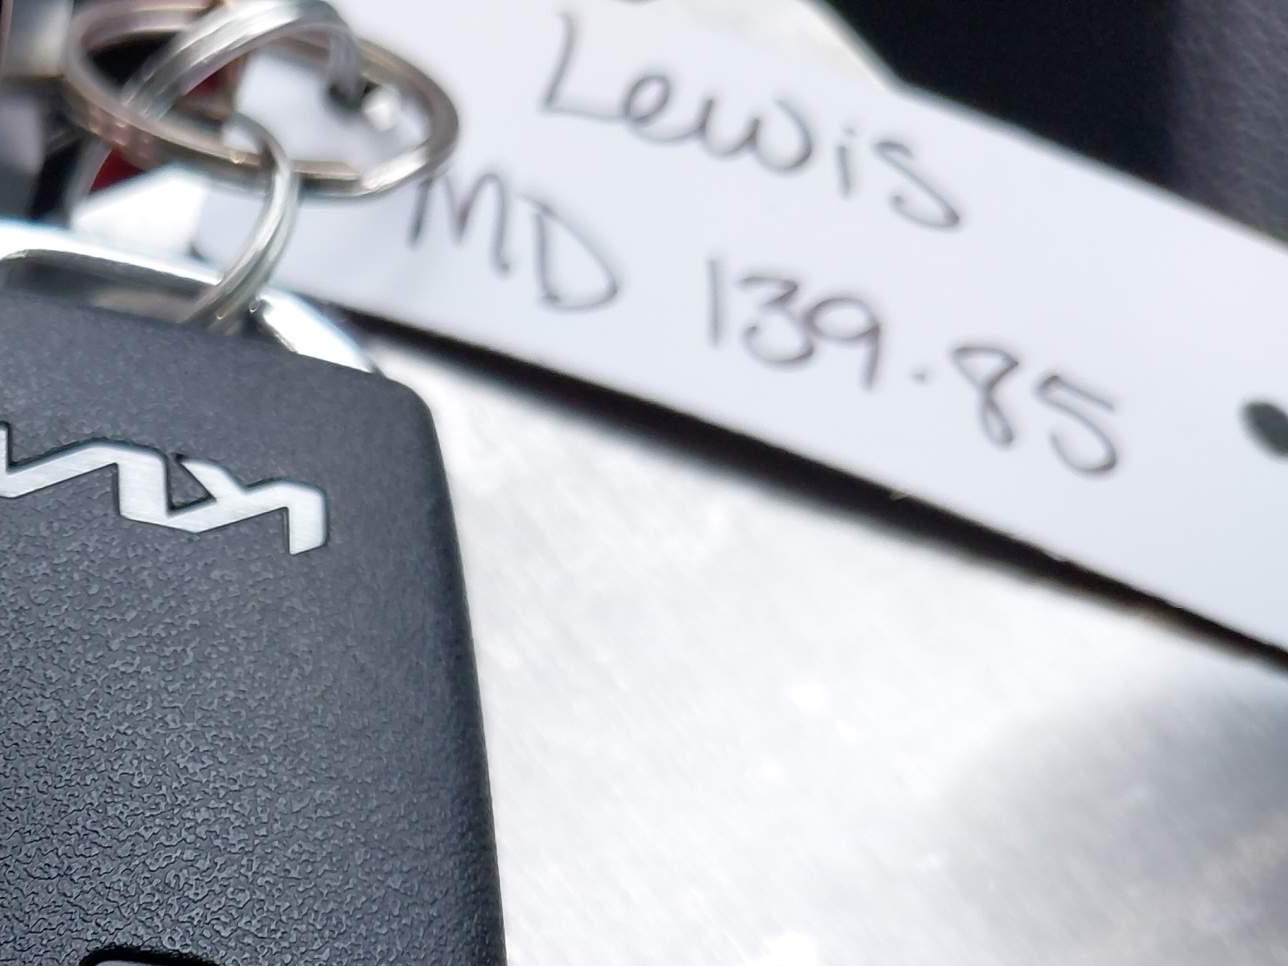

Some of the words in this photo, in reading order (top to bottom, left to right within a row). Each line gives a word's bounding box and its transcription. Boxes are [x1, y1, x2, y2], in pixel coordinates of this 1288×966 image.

[538, 12, 963, 231] Lewis
[406, 168, 620, 314] MD
[706, 256, 1120, 476] 139.85
